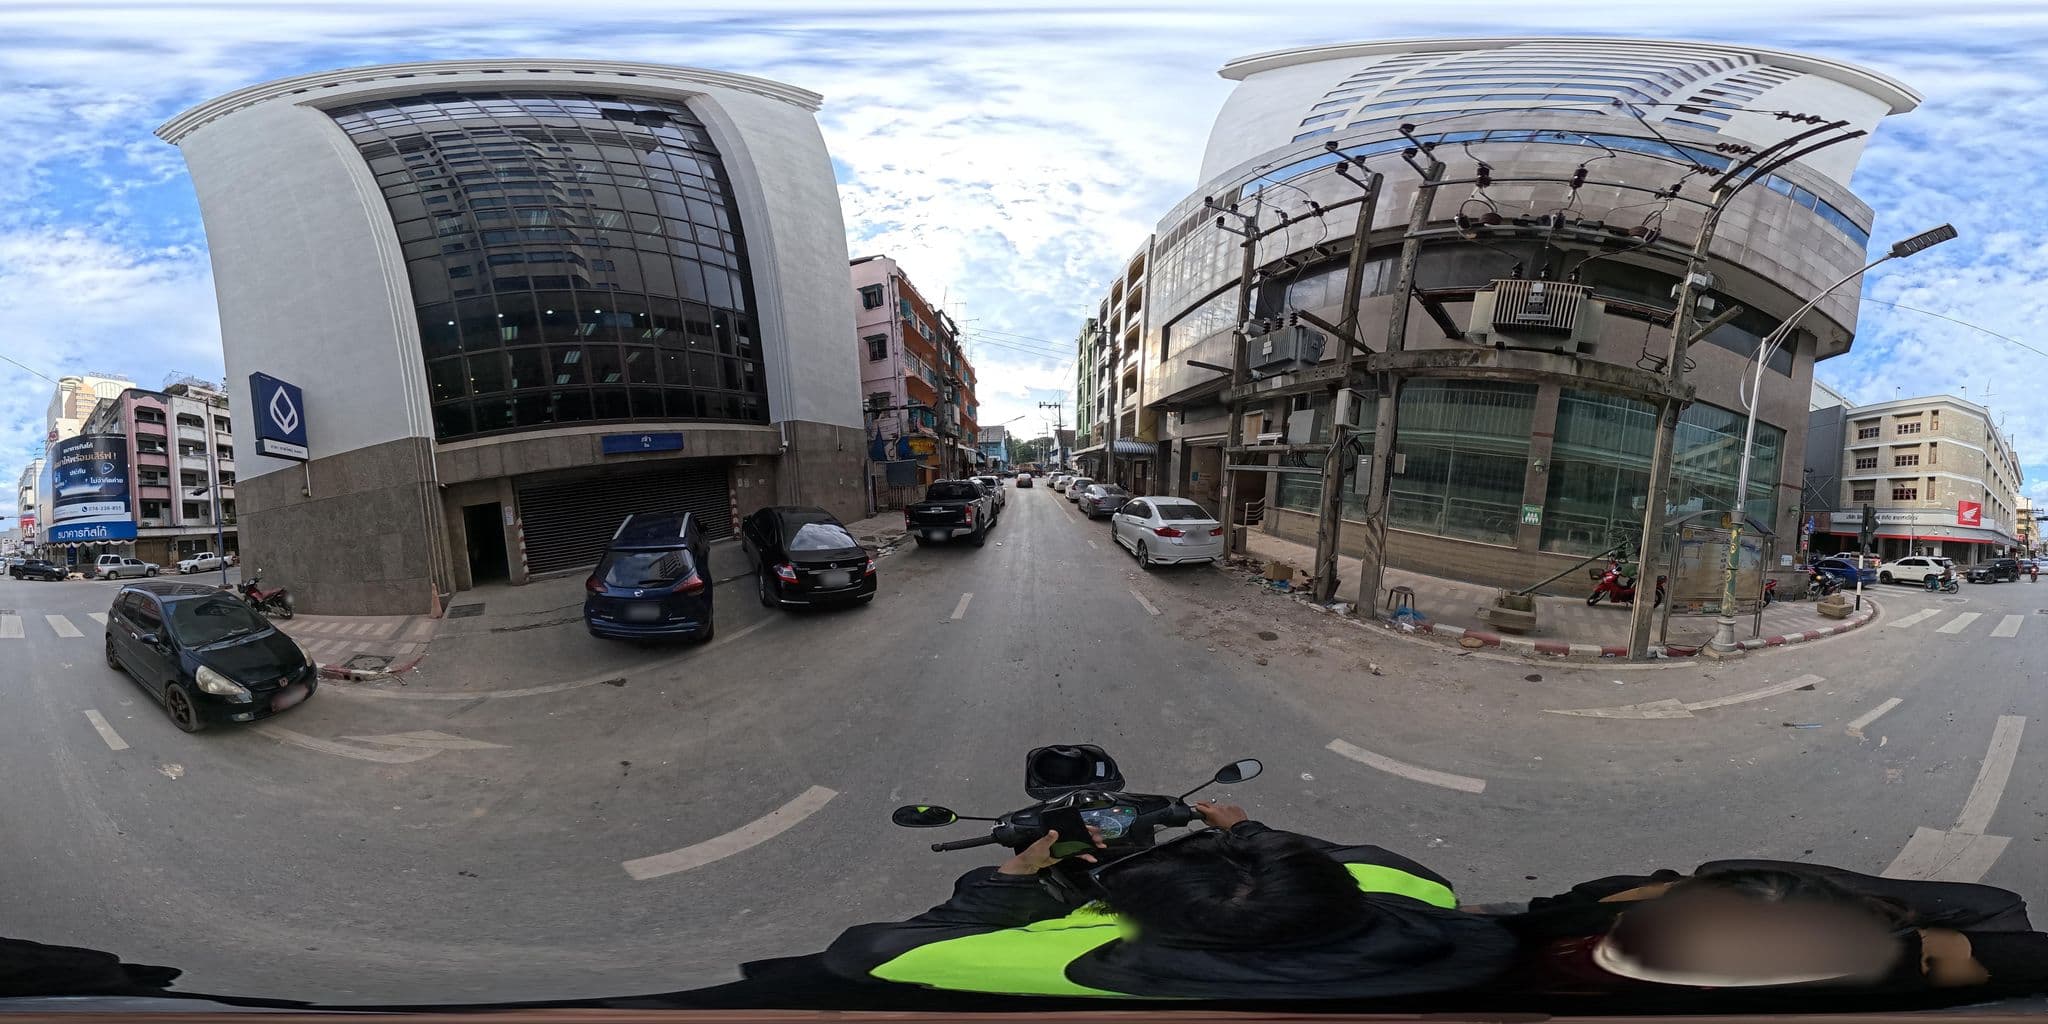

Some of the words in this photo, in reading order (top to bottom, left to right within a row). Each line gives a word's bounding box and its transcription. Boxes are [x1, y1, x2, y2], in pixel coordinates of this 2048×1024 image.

[58, 525, 107, 539] ธนาคารทิสโก้
